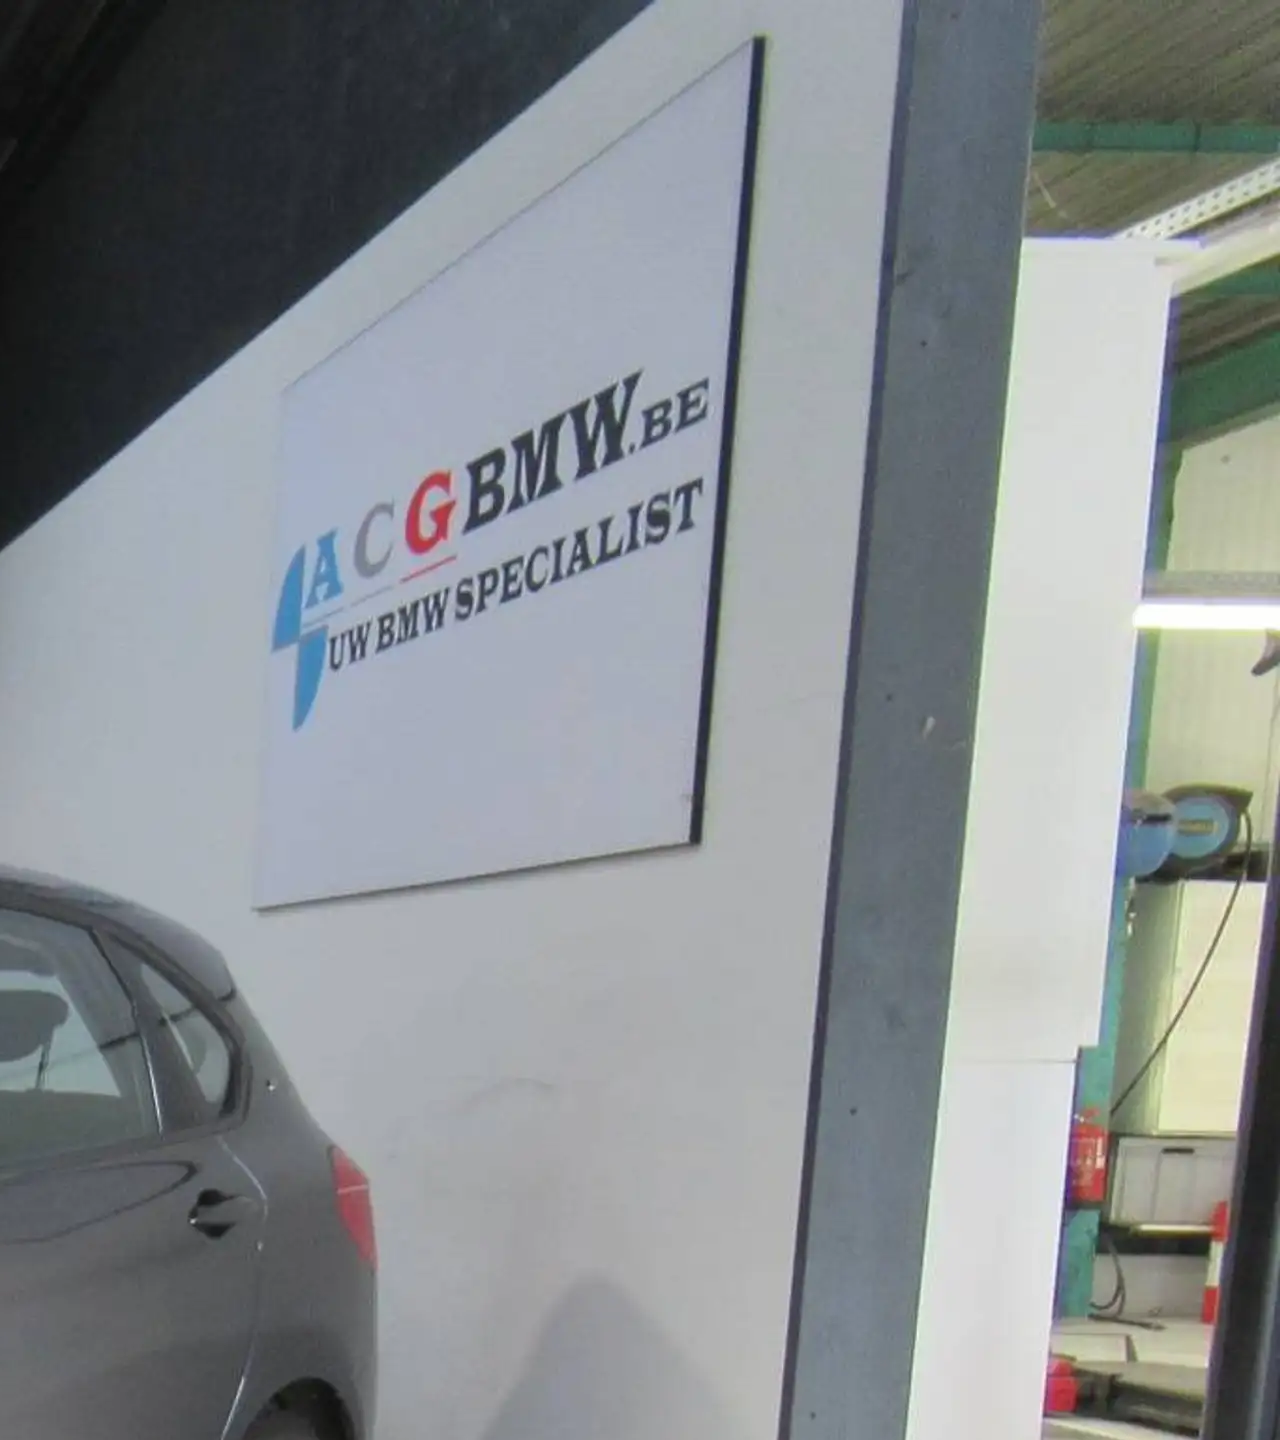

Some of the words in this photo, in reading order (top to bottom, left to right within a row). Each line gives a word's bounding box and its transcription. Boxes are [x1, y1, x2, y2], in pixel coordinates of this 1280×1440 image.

[328, 621, 372, 671] UW
[376, 587, 451, 655] BMW
[454, 478, 704, 622] SPECIALIST
